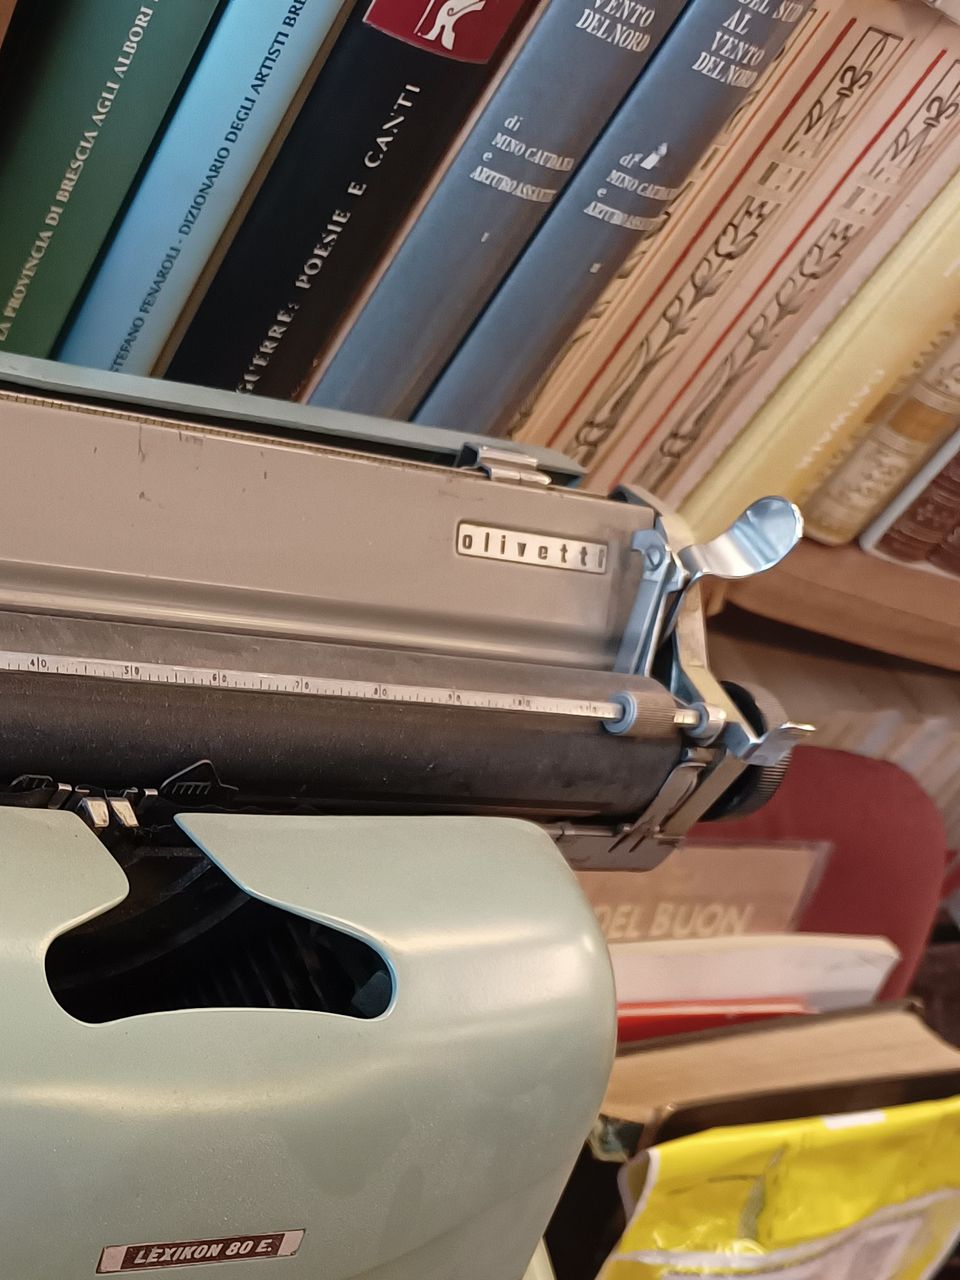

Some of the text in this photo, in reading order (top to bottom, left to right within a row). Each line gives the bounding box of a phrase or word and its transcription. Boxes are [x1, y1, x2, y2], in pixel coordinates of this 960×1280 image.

[576, 8, 651, 53] DEL NORD
[722, 9, 752, 35] AL
[710, 31, 765, 66] VENTO
[691, 52, 726, 80] DEL
[504, 115, 524, 132] di
[482, 152, 493, 162] e
[491, 132, 527, 157] MINO
[3, 230, 54, 318] PROVINCIA
[45, 205, 65, 226] DI
[55, 131, 99, 203] BRESCIA
[91, 81, 121, 127] AGLI
[113, 6, 154, 79] ALBORI
[139, 246, 182, 316] FENAROLI
[178, 146, 231, 236] DIZIONARIO
[224, 96, 257, 144] DEGLI
[250, 31, 290, 95] ARTISTI
[295, 209, 352, 289] POESIE
[347, 181, 367, 196] E
[364, 84, 420, 168] CANTI
[470, 165, 516, 193] ARTURO
[597, 187, 607, 197] e
[606, 170, 638, 193] MINO
[462, 532, 606, 569] olivetti
[133, 1243, 224, 1265] LEXIKON
[225, 1241, 252, 1256] 80
